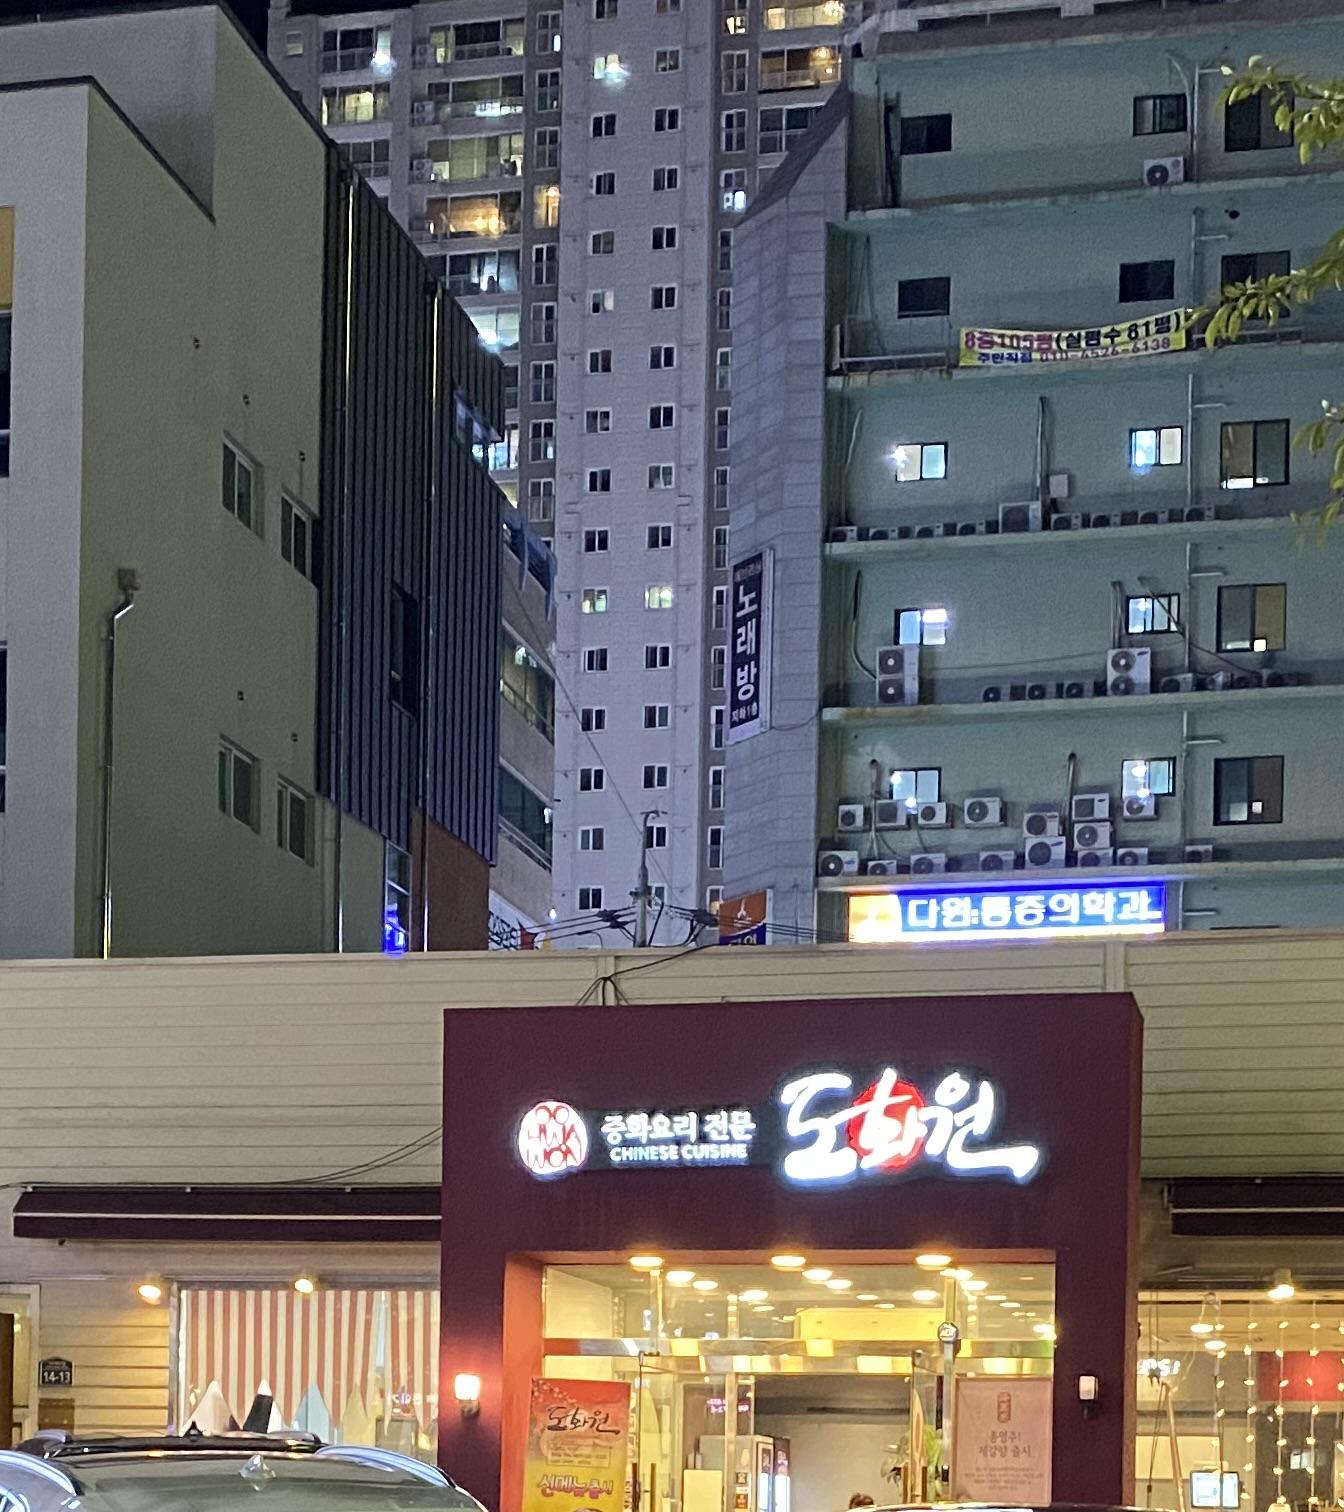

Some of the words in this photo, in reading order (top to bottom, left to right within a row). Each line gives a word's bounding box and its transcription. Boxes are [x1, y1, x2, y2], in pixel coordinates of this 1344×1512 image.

[735, 584, 759, 701] 노래방
[601, 1112, 699, 1144] 중화요리
[704, 1110, 756, 1141] 전문
[781, 1067, 1039, 1179] 도화원
[609, 1145, 679, 1162] CHINESE
[681, 1143, 748, 1160] CUISINE
[43, 1371, 71, 1383] 14-13
[547, 1406, 621, 1435] 도화원
